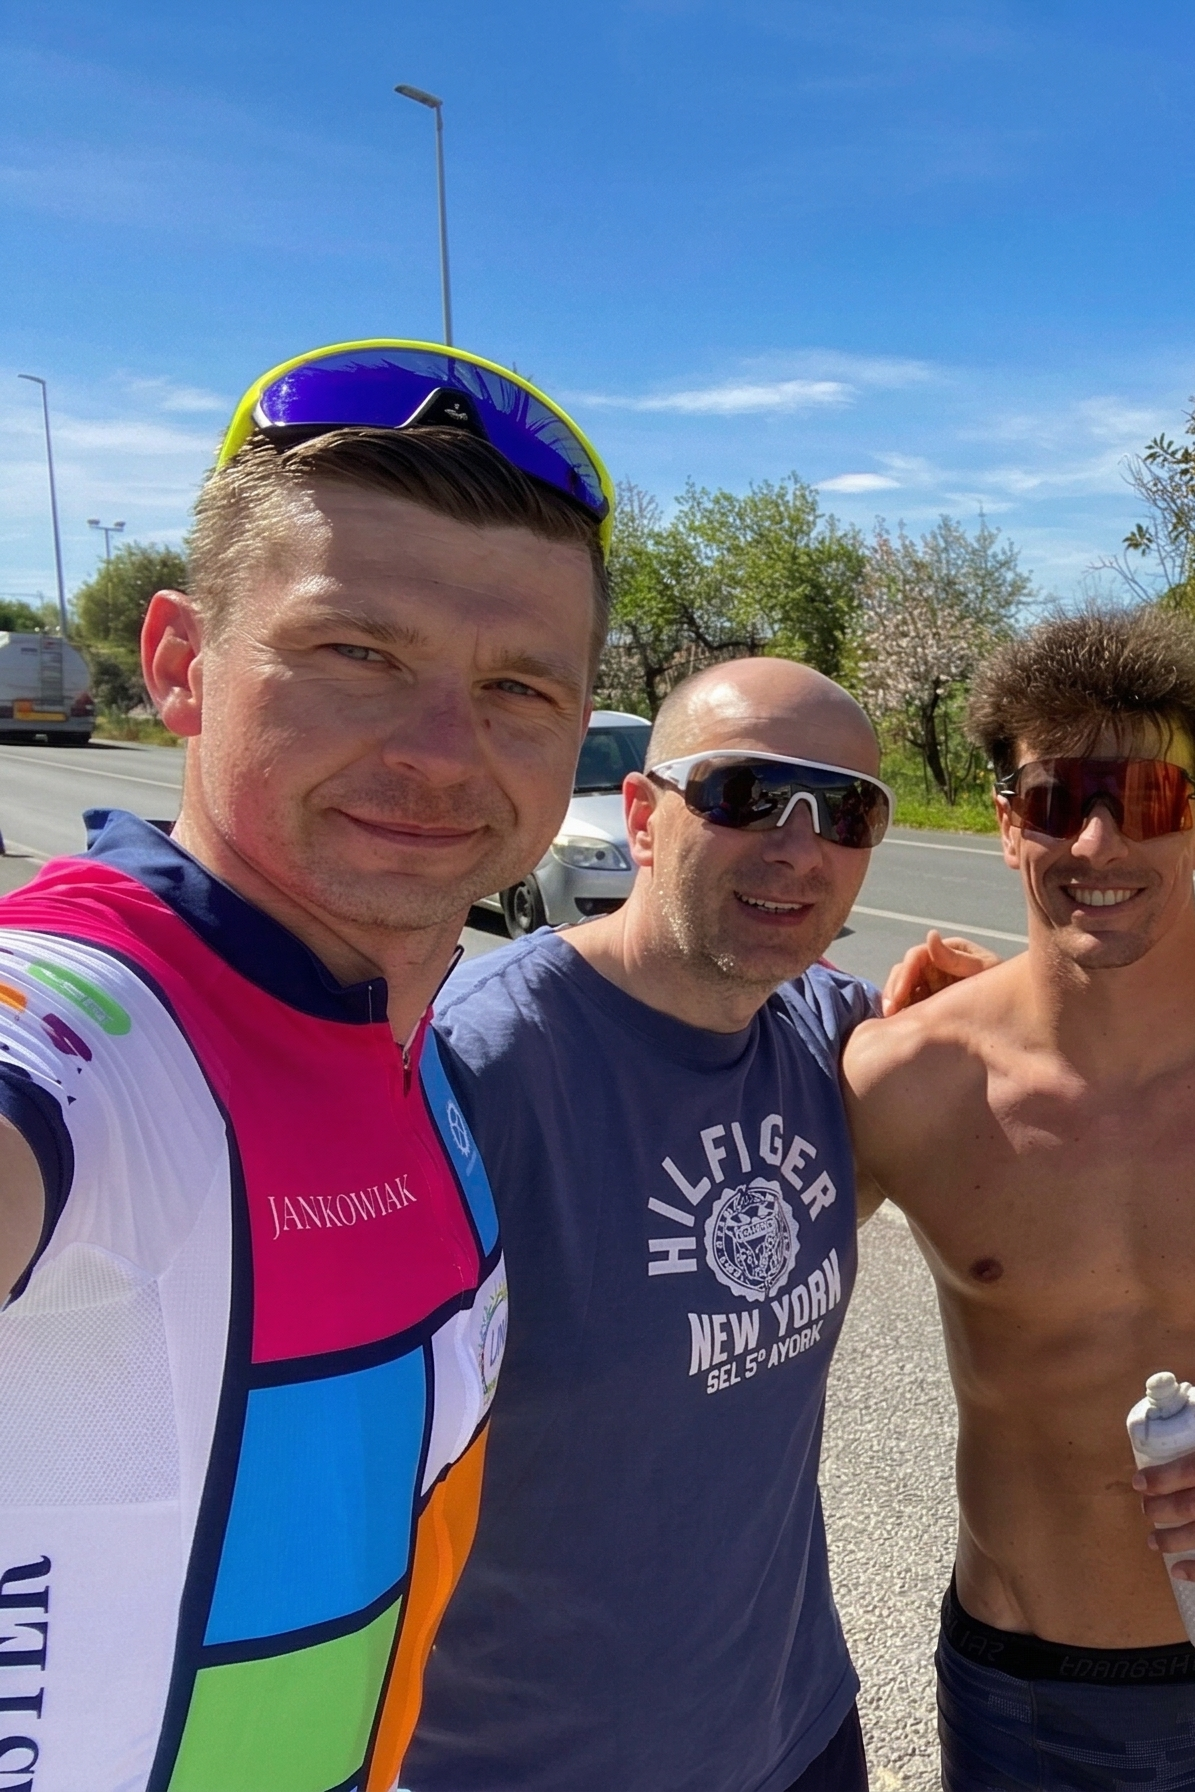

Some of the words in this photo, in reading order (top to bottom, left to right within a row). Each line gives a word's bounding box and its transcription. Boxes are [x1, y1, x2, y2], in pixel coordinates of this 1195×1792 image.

[267, 1173, 417, 1240] JANKOWIAK
[648, 1113, 837, 1276] HILFIGER
[687, 1309, 760, 1376] NEW
[706, 1361, 742, 1395] SEL
